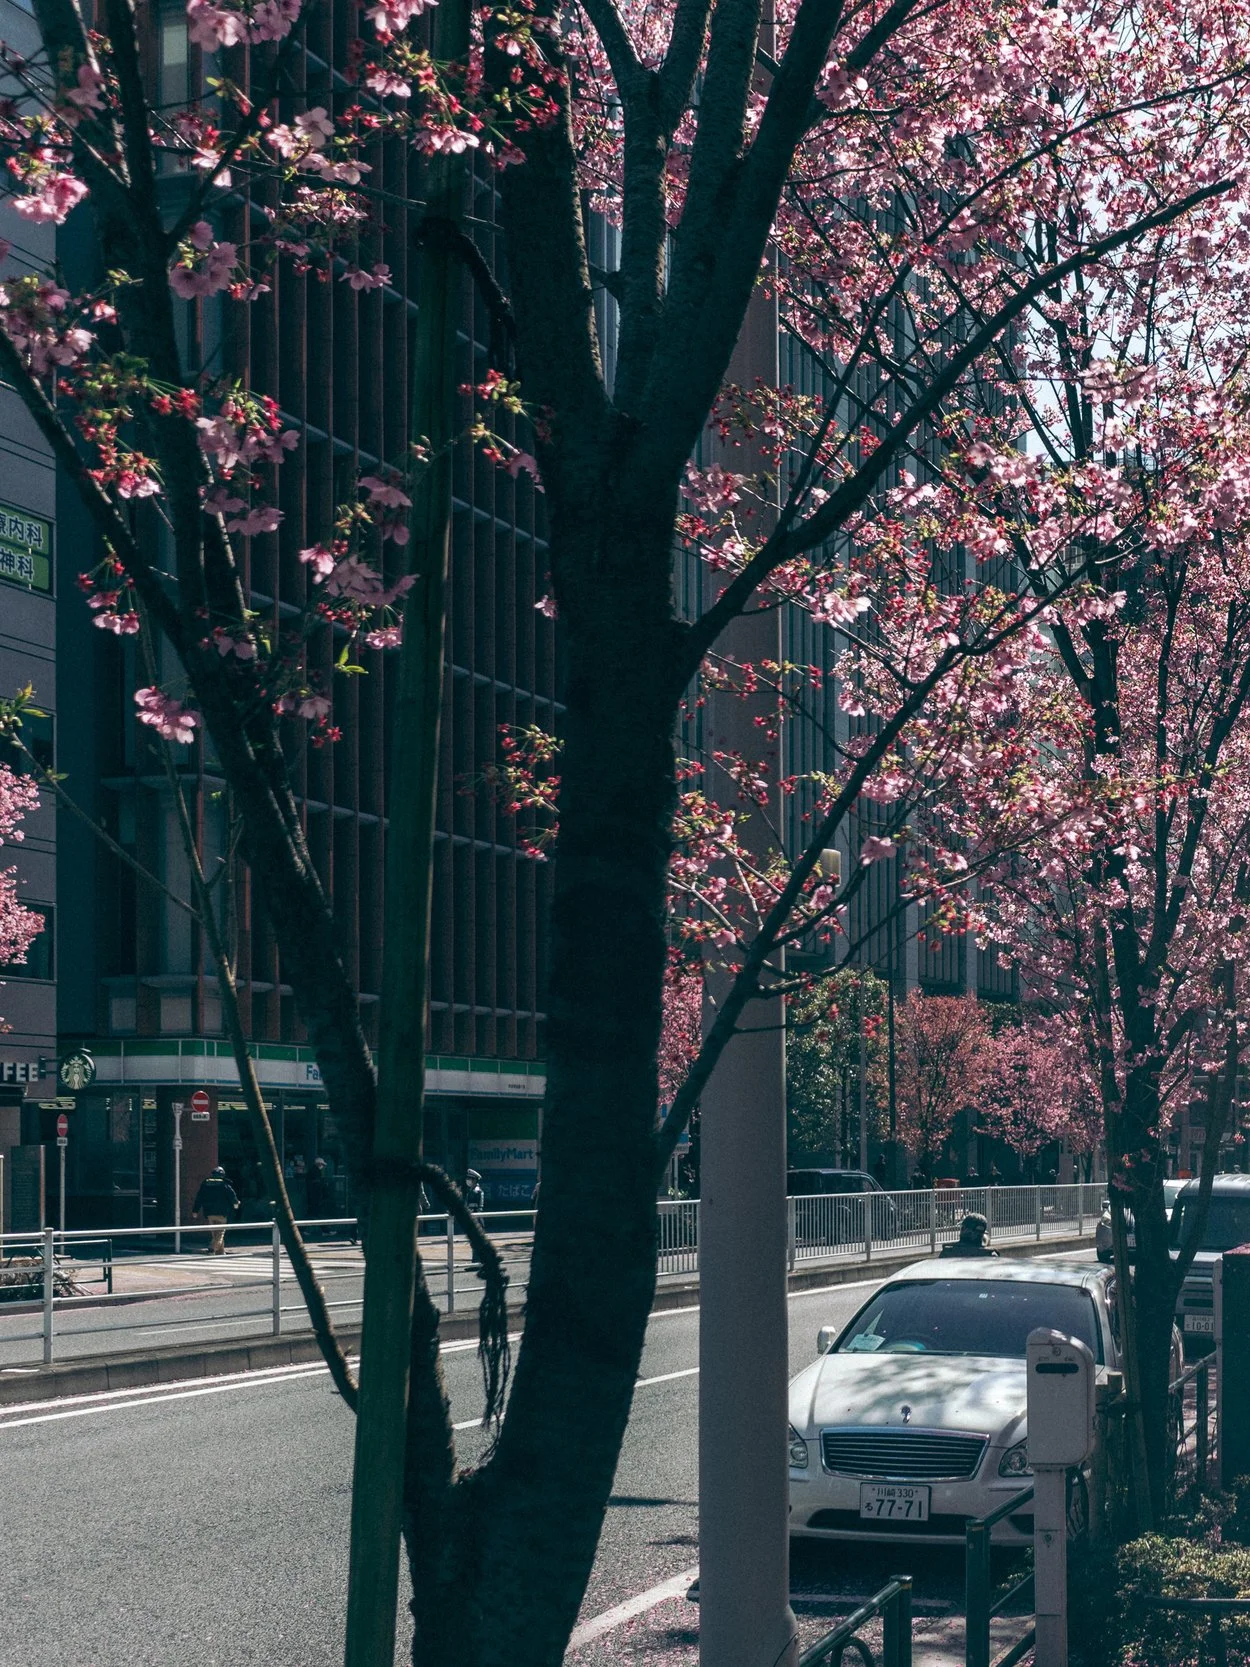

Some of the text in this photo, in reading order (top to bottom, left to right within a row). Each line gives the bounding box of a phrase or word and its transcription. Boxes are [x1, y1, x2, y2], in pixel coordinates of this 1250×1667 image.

[471, 1147, 533, 1162] FamilyMart
[498, 1183, 531, 1197] たばこ
[876, 1487, 914, 1499] 川崎 330
[875, 1498, 923, 1519] 77-71
